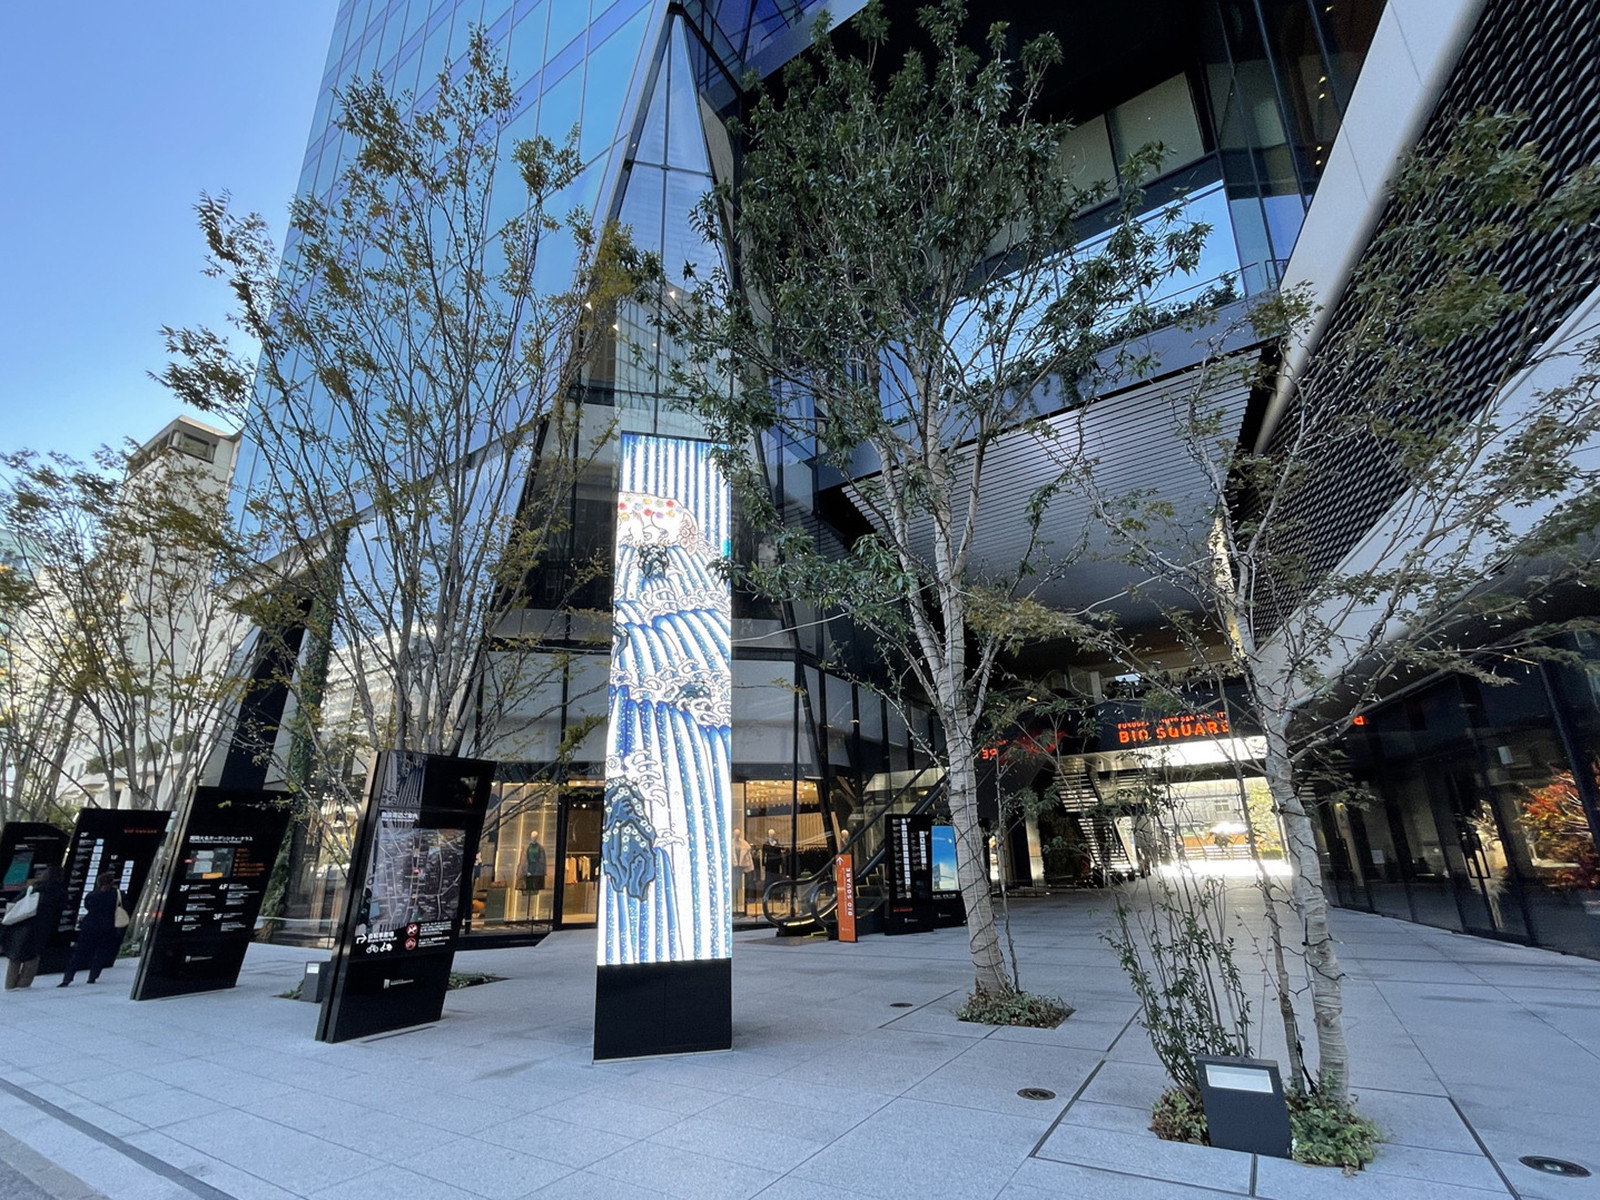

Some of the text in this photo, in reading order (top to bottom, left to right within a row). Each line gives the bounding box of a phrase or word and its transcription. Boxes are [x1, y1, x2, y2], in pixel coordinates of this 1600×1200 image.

[1118, 720, 1229, 744] BIO SQUARE
[179, 884, 190, 892] 2F
[213, 913, 223, 921] 3F
